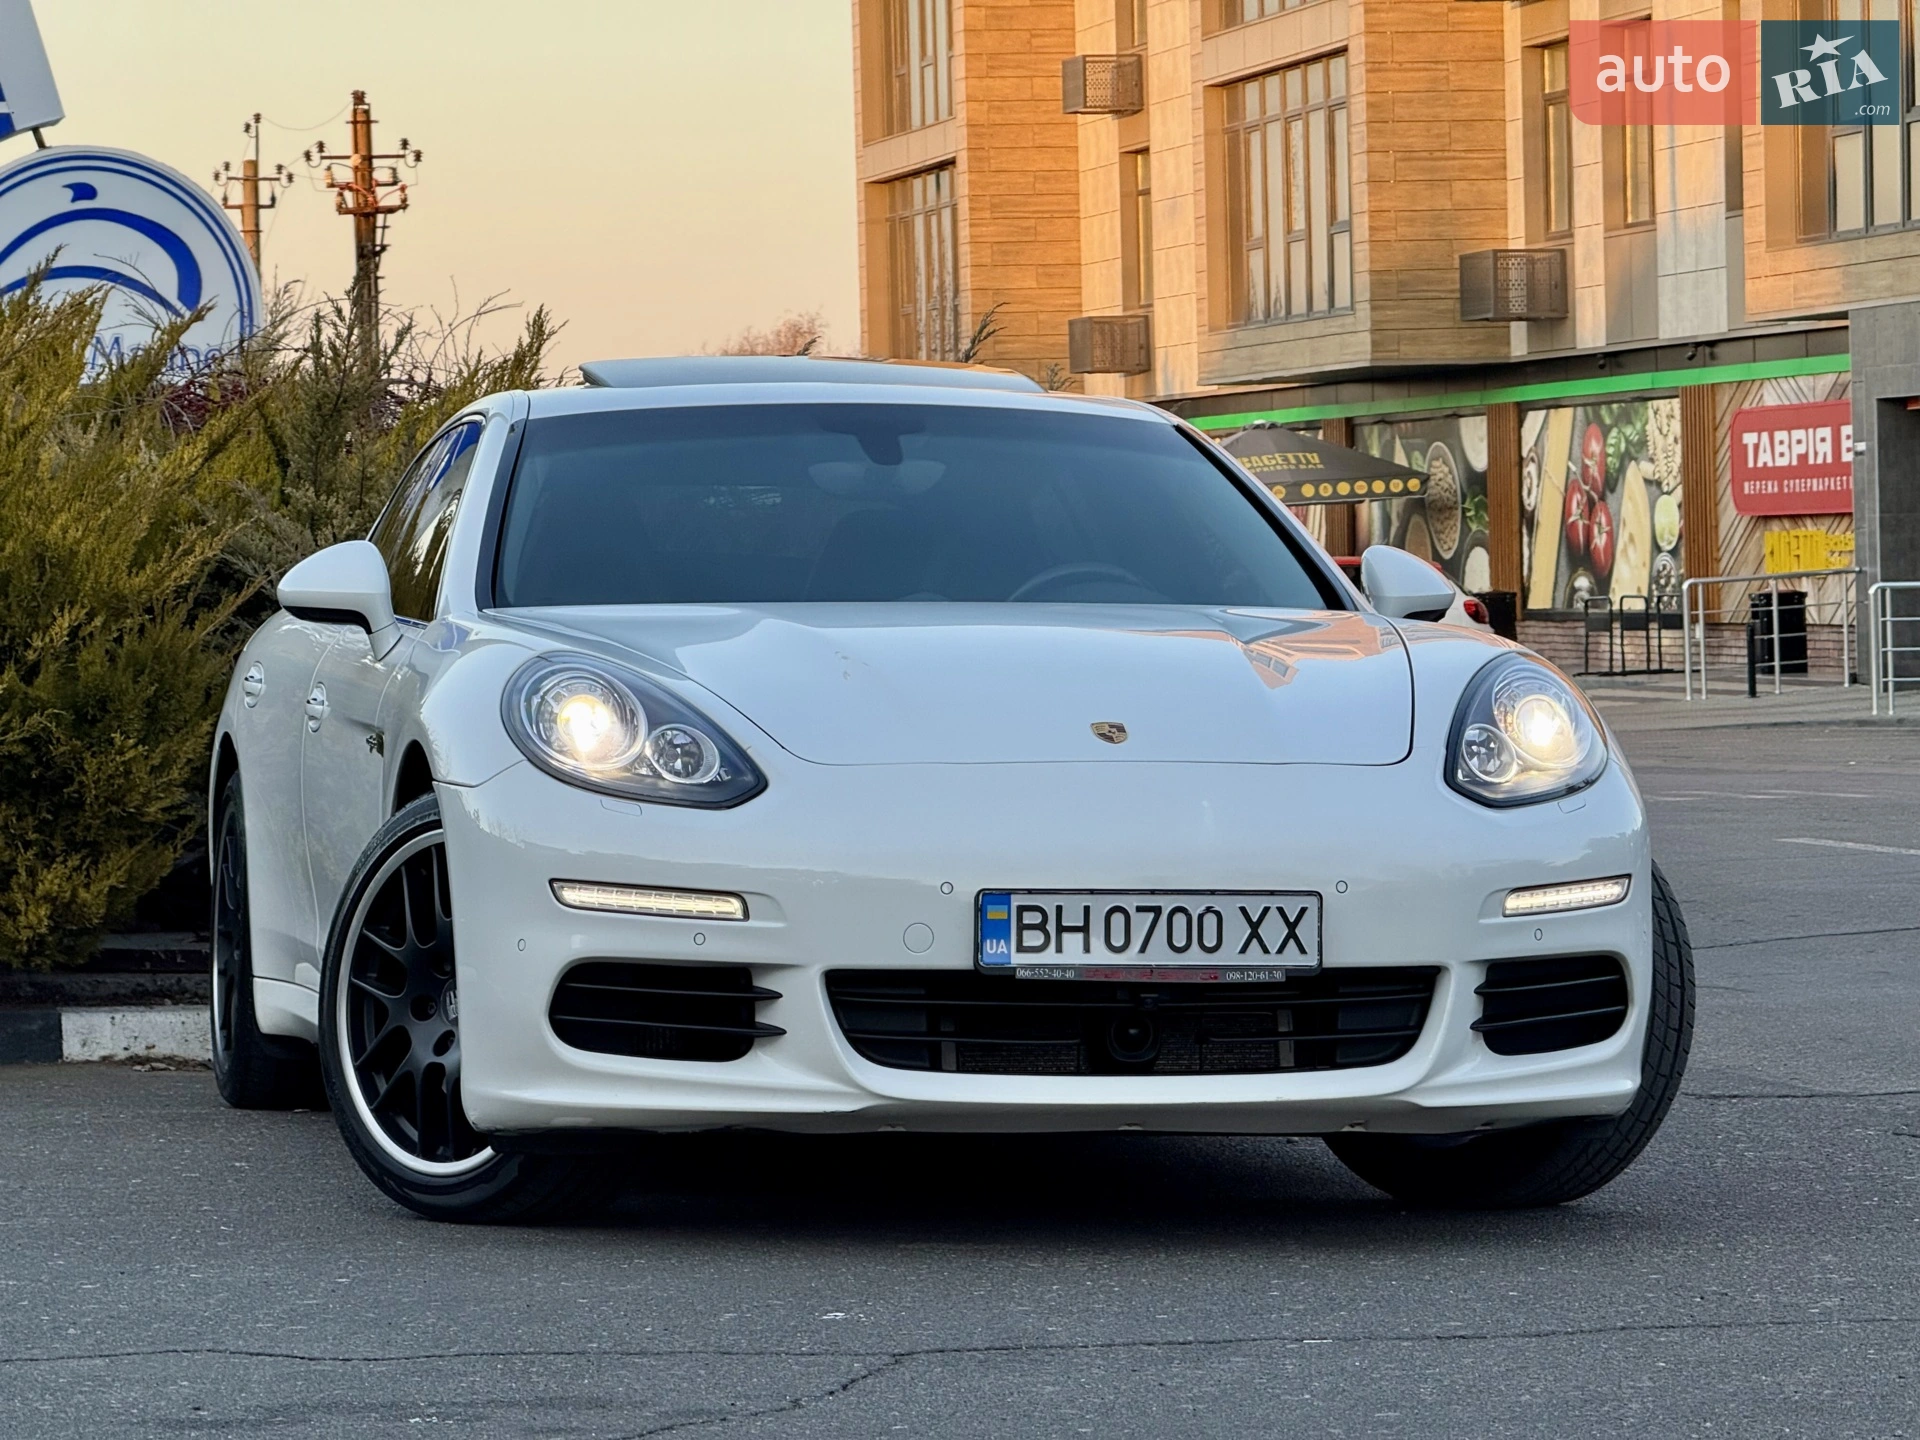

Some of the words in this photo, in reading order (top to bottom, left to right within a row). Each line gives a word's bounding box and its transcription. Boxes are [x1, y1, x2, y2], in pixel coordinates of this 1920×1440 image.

[1742, 427, 1833, 468] ТАВРІЯ
[1744, 480, 1778, 494] МЕРЕЖА
[1015, 904, 1091, 954] BH
[1104, 904, 1224, 954] 0700
[1237, 905, 1309, 955] XX
[986, 940, 1008, 954] UA
[1016, 967, 1075, 979] 066-552-40-40
